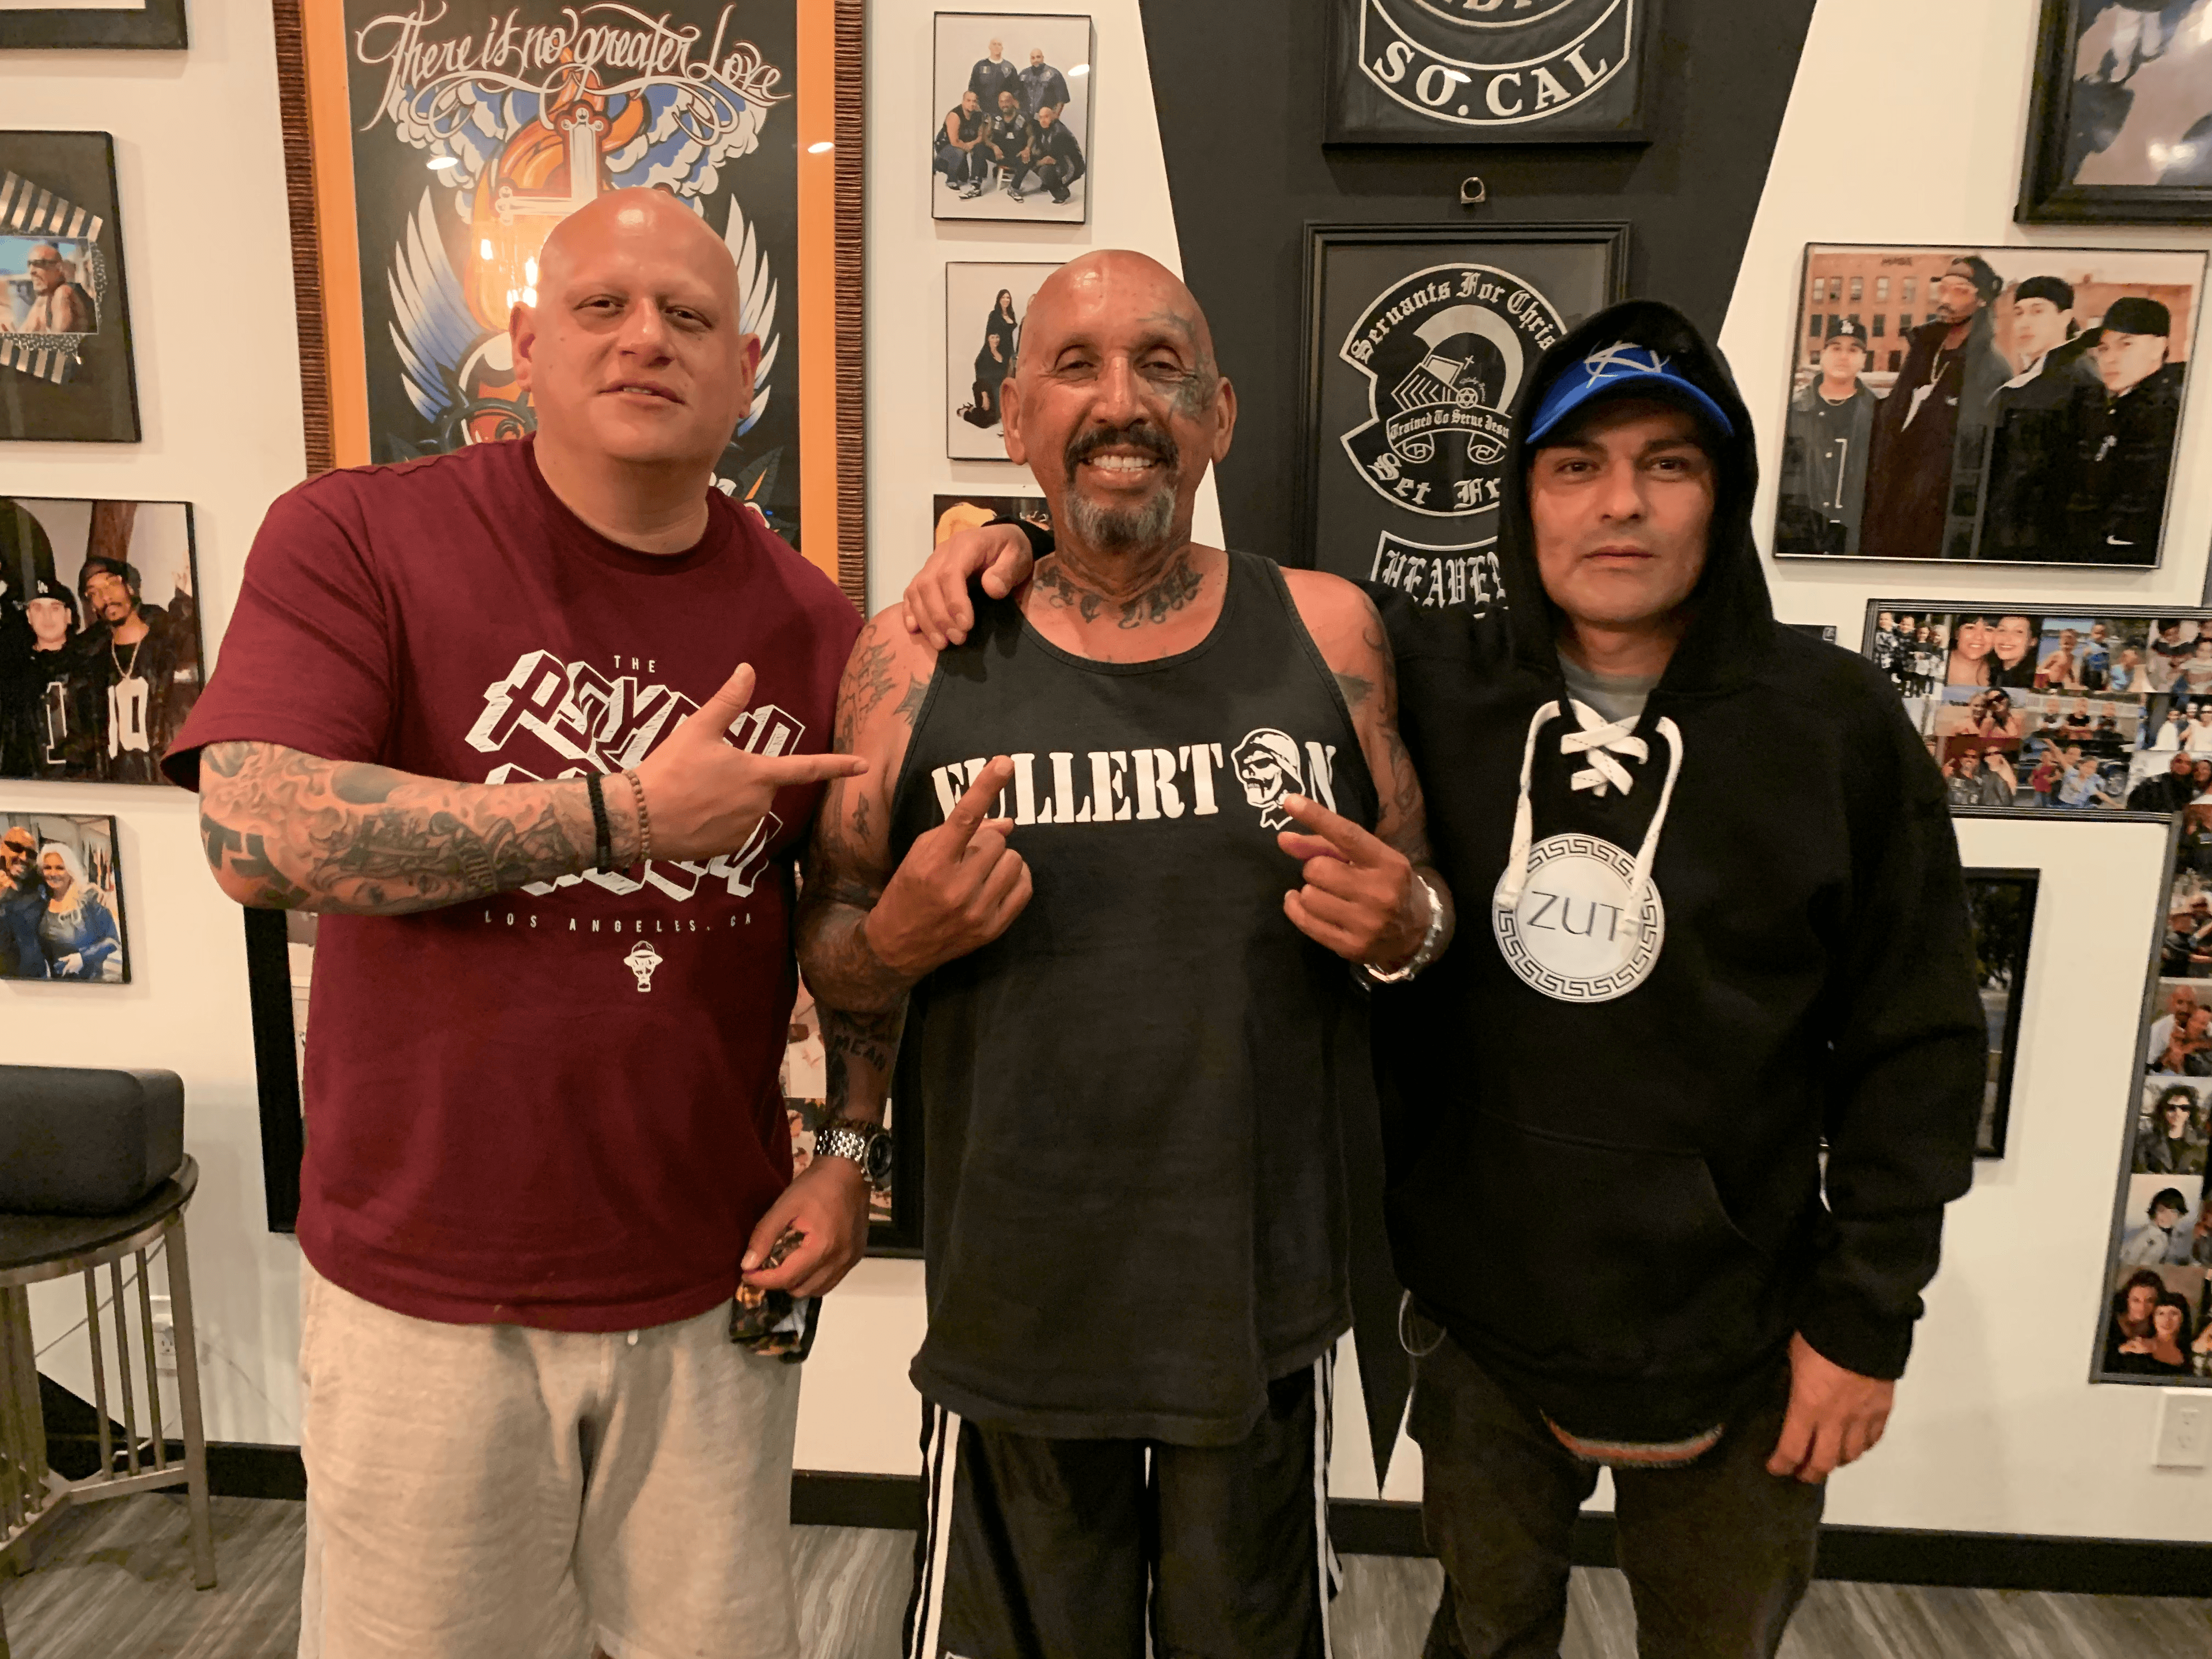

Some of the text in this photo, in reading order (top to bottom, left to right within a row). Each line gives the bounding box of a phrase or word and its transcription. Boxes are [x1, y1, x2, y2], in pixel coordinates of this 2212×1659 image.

[522, 8, 578, 70] no
[569, 3, 700, 101] greater
[687, 4, 791, 106] Love
[1456, 271, 1506, 304] For
[1389, 412, 1433, 440] Trained
[1434, 409, 1450, 425] To
[1367, 452, 1431, 505] Set
[613, 654, 656, 673] THE
[484, 910, 538, 929] LOS
[730, 912, 751, 927] CA
[1527, 890, 1627, 942] ZUT
